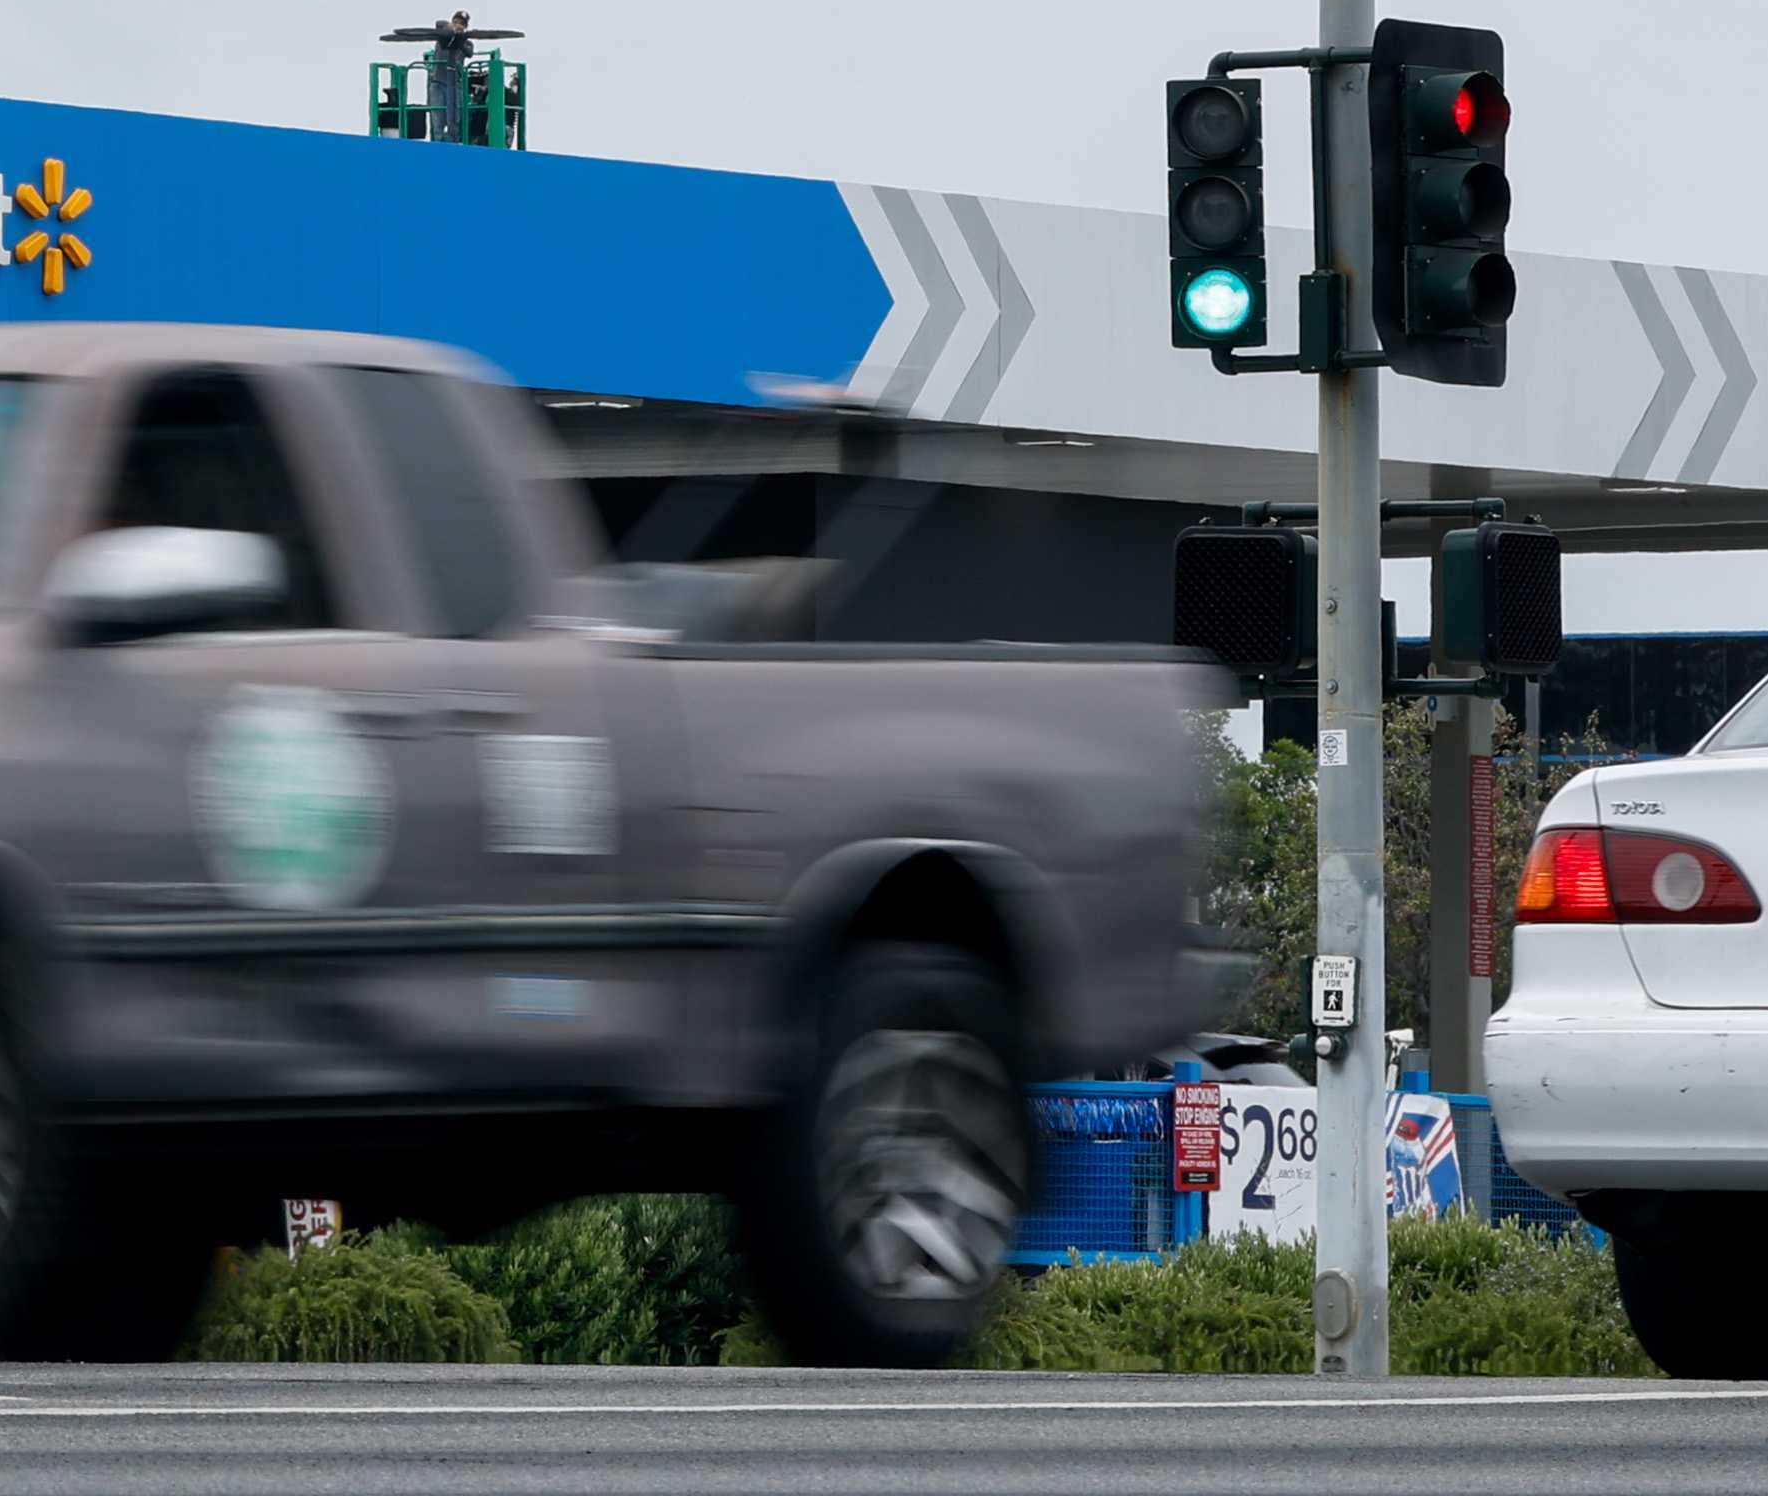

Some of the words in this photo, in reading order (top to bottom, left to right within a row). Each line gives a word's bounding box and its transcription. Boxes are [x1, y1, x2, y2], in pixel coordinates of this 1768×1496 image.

[1610, 800, 1665, 815] TOYOTA
[1176, 1088, 1186, 1104] NO
[1187, 1088, 1219, 1104] SMOKING
[1175, 1107, 1193, 1125] STOP
[1195, 1107, 1220, 1125] ENGINE
